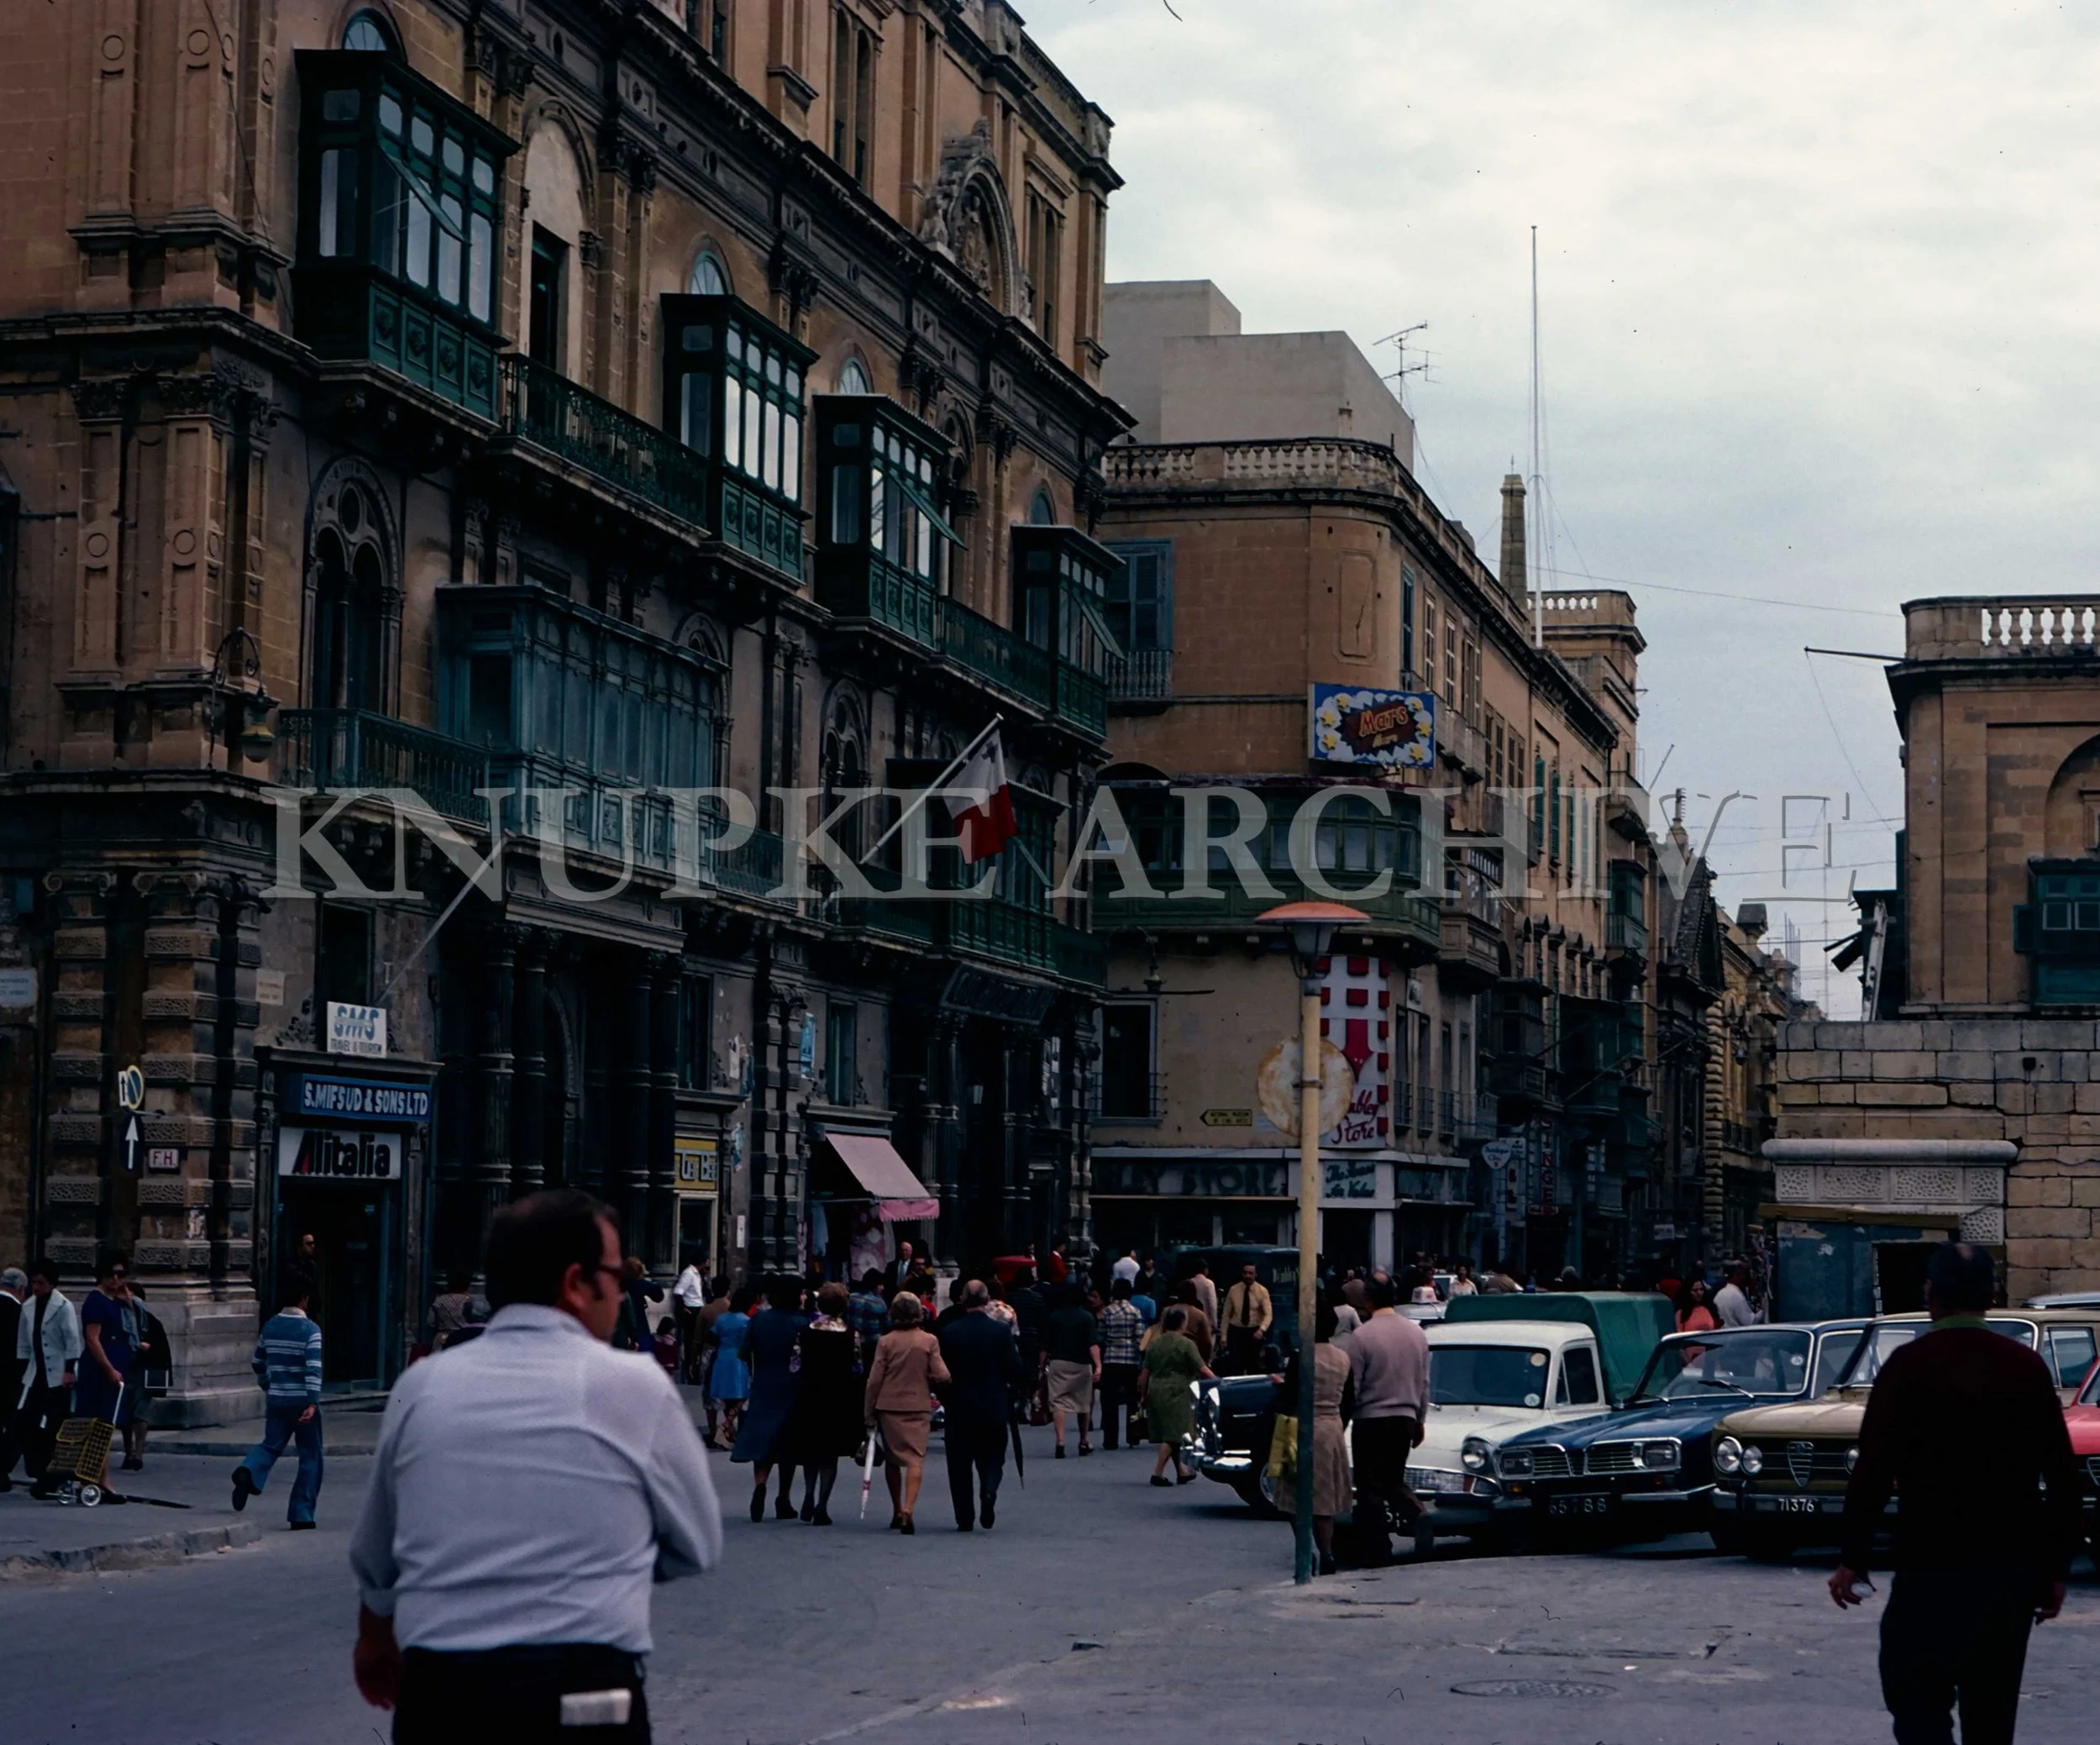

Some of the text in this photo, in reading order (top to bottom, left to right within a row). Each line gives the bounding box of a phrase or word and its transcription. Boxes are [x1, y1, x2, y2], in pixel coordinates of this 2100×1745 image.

[1357, 707, 1410, 738] Mars
[364, 1088, 374, 1113] &
[375, 1089, 405, 1116] SONS
[406, 1091, 429, 1117] LTD
[1331, 1115, 1375, 1144] Store
[292, 1130, 391, 1176] Alitalia
[1777, 1497, 1815, 1512] 71376
